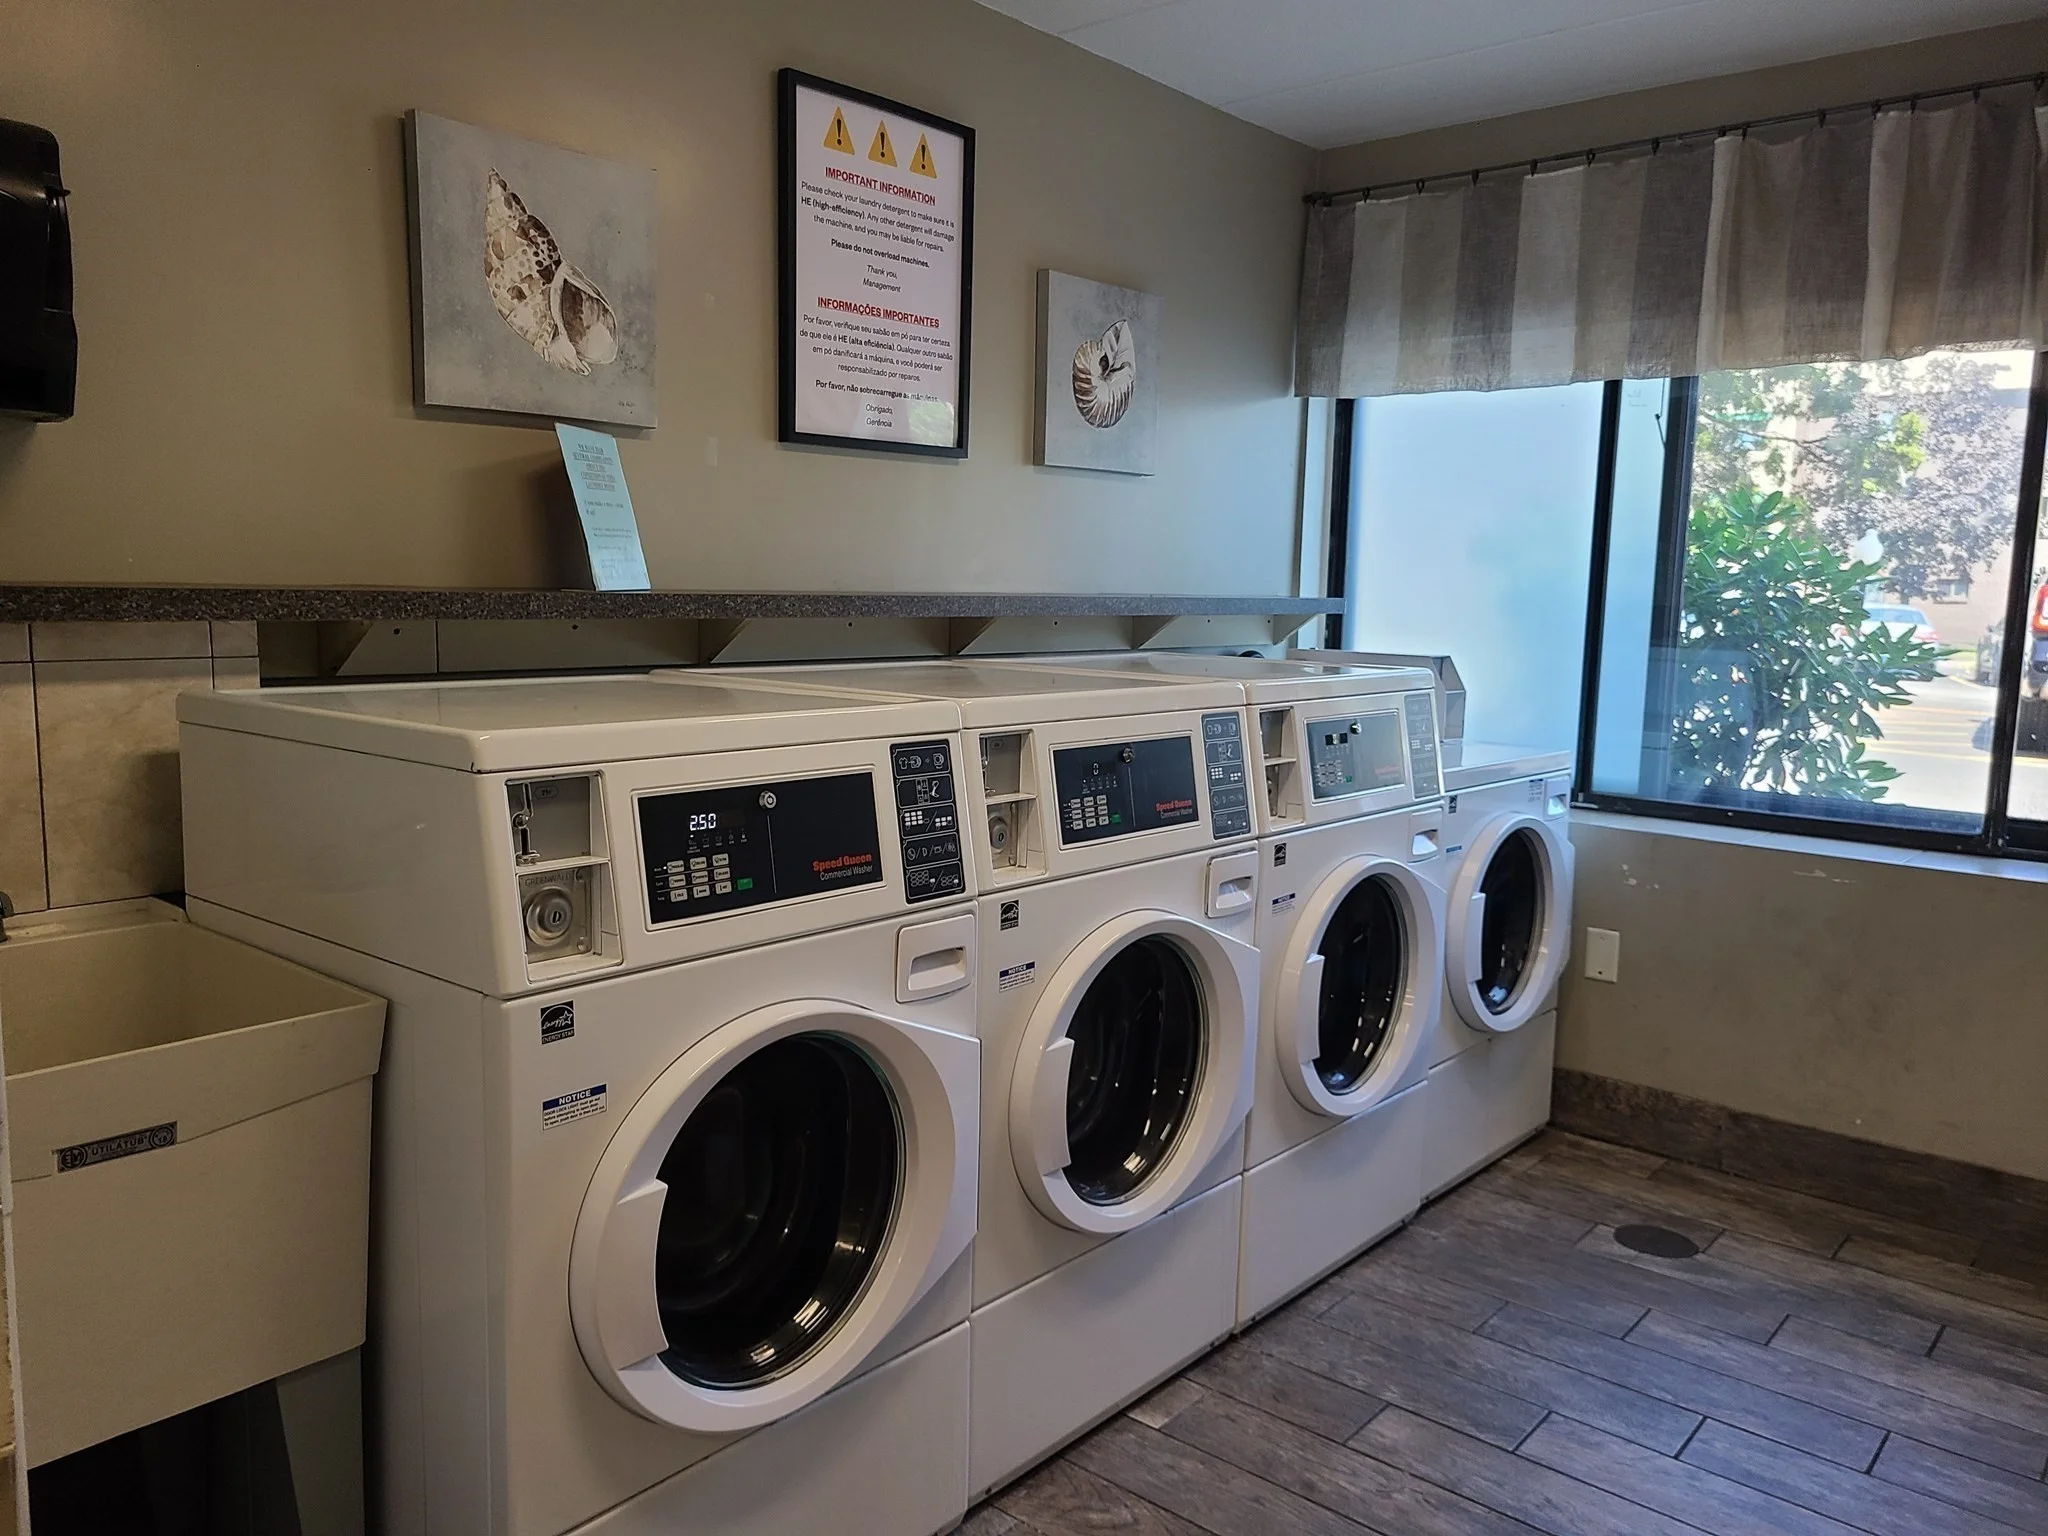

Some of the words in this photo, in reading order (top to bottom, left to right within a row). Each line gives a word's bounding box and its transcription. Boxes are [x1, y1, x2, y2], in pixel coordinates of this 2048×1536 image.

[825, 166, 878, 190] IMPORTANT
[880, 181, 936, 205] INFORMATION
[801, 181, 823, 194] Please
[824, 188, 843, 199] check
[844, 194, 858, 203] your
[859, 196, 881, 210] laundry
[882, 203, 910, 216] detergent
[917, 213, 932, 222] make
[933, 218, 944, 226] sure
[801, 196, 811, 206] HE
[812, 198, 866, 220] (high-efficiency).
[867, 212, 879, 223] Any
[880, 216, 895, 226] other
[896, 220, 923, 233] detergent
[924, 228, 932, 236] will
[933, 230, 954, 242] damage
[814, 214, 824, 224] the
[826, 218, 853, 232] machine,
[854, 224, 866, 234] and
[867, 228, 877, 236] you
[879, 231, 891, 240] may
[892, 232, 899, 241] be
[900, 235, 915, 245] liable
[916, 238, 924, 247] for
[925, 242, 944, 252] repairs.
[831, 239, 852, 250] Please
[853, 244, 862, 252] do
[862, 248, 873, 256] not
[874, 250, 900, 261] overload
[901, 255, 930, 268] machines.
[867, 264, 885, 276] Thank
[886, 270, 898, 279] you,
[863, 278, 900, 292] Management
[817, 296, 882, 318] INFORMAÇÕES
[883, 308, 940, 328] IMPORTANTES
[803, 314, 814, 324] Por
[816, 316, 833, 328] favor,
[834, 320, 860, 332] verifique
[861, 326, 871, 334] seu
[872, 327, 890, 337] sabão
[901, 332, 908, 342] pó
[909, 334, 921, 343] para
[930, 338, 951, 347] certeza
[800, 329, 808, 337] de
[809, 331, 821, 340] que
[823, 332, 832, 341] ele
[833, 333, 837, 341] é
[838, 334, 848, 343] HE
[849, 335, 862, 346] (alta
[896, 344, 921, 356] Qualquer
[922, 350, 936, 358] outro
[937, 353, 953, 361] sabão
[824, 347, 832, 356] pó
[833, 348, 863, 360] danificará
[868, 355, 895, 366] máquina,
[914, 361, 933, 371] poderá
[837, 363, 887, 377] responsabilizado
[888, 371, 898, 379] por
[899, 372, 921, 381] reparos.
[815, 379, 827, 388] Por
[828, 381, 845, 392] favor,
[846, 385, 858, 393] não
[859, 387, 902, 399] sobrecarregue
[865, 403, 893, 415] Obrigado,
[866, 417, 892, 428] Gerência
[689, 813, 716, 831] 2.50
[812, 856, 843, 871] Speed
[843, 854, 872, 866] Queen
[820, 867, 853, 881] Commercial
[852, 864, 873, 875] Washer
[1008, 964, 1027, 975] NOTICE
[558, 1090, 591, 1105] NOTICE
